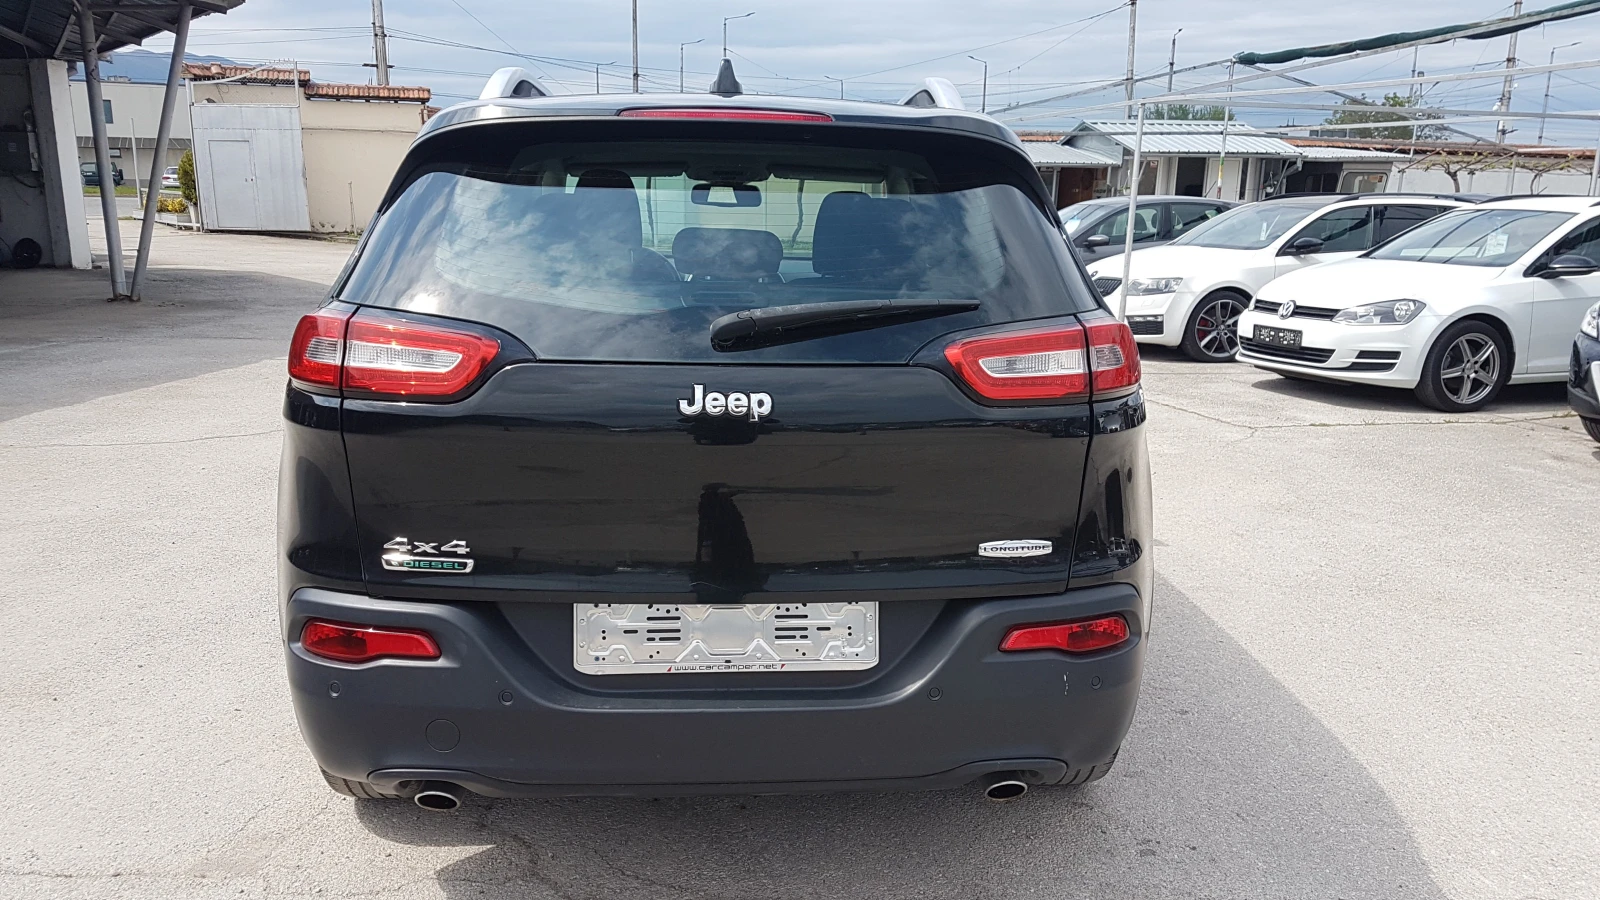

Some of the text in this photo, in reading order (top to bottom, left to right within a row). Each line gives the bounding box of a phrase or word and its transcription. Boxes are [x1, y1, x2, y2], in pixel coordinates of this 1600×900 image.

[678, 384, 772, 421] Jeep
[383, 536, 471, 554] 4x4
[403, 560, 464, 569] DIESEL
[674, 663, 778, 671] www.carcamper.net
